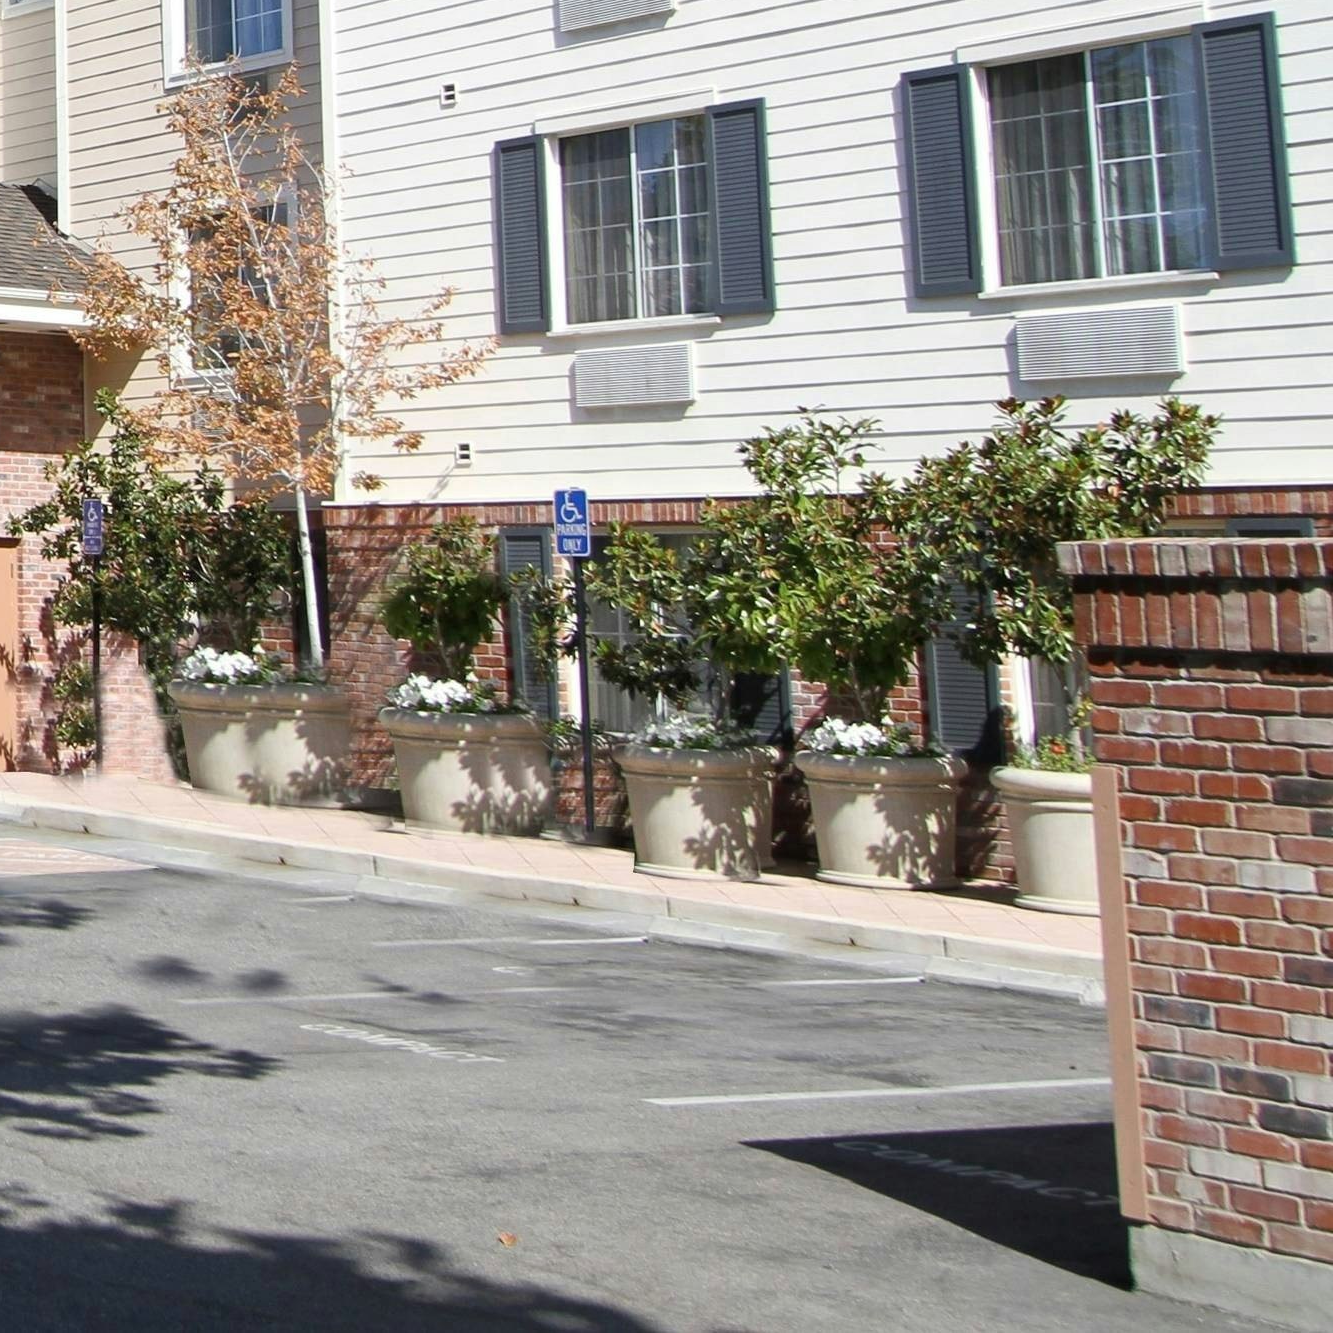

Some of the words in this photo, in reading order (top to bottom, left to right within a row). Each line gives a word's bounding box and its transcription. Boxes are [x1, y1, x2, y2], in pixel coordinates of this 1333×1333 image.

[557, 523, 586, 536] PARKING
[563, 538, 582, 551] ONLY
[299, 1023, 506, 1063] COMPACT
